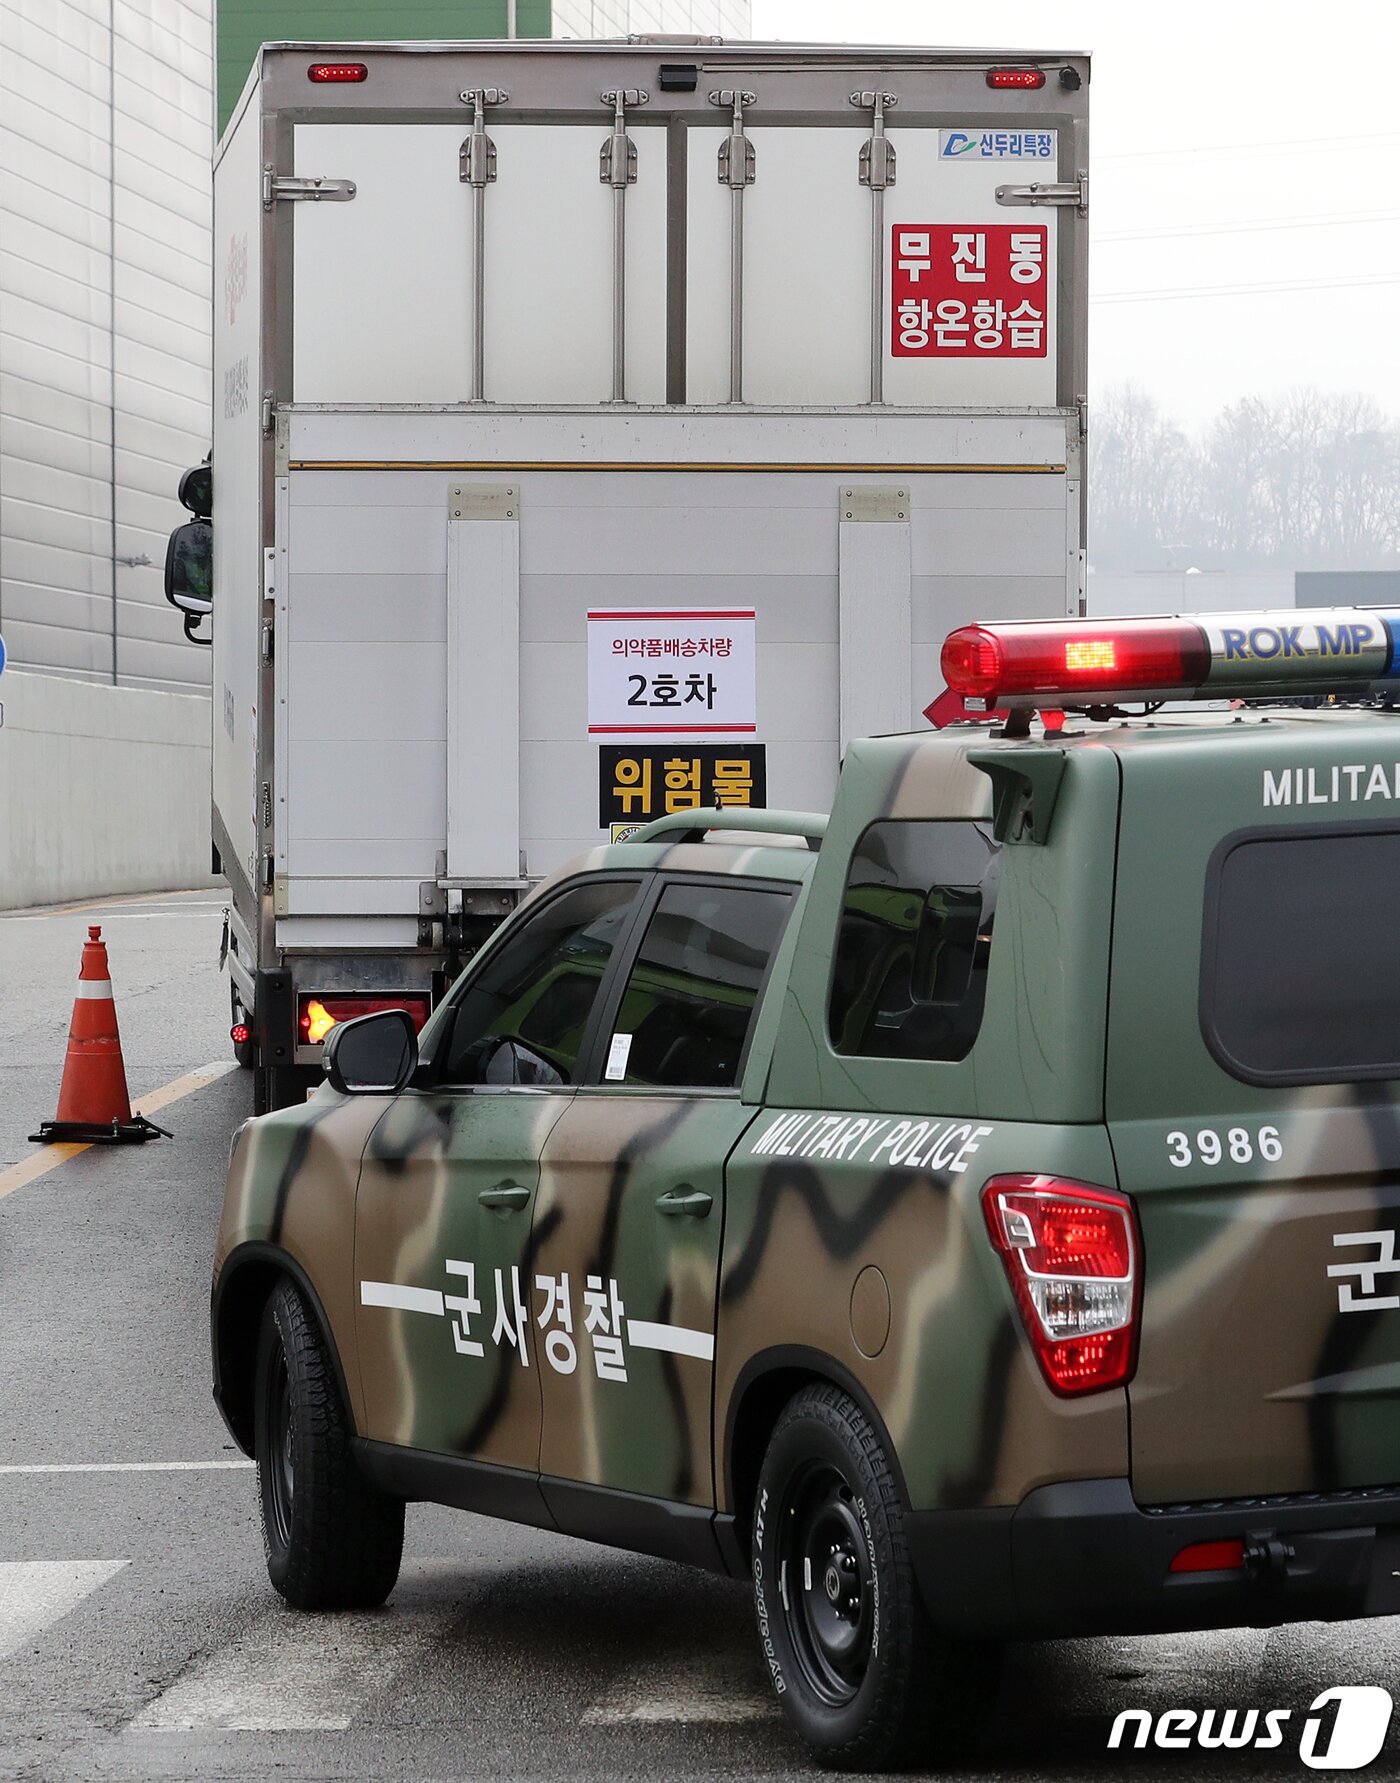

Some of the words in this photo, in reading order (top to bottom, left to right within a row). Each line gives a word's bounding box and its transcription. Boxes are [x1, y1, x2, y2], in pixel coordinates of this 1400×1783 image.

[979, 133, 1052, 157] 신두리특장
[897, 298, 1045, 350] 항온항습
[611, 637, 733, 658] 의약품배송차량
[1219, 625, 1307, 662] ROK
[1313, 623, 1375, 657] MP
[627, 672, 718, 710] 2호차
[612, 757, 754, 814] 위험물
[1263, 762, 1400, 807] MILITA
[750, 1113, 892, 1161] MILITARY
[868, 1120, 994, 1173] POLICE
[1166, 1125, 1284, 1169] 3986
[444, 1258, 628, 1383] 군사경찰
